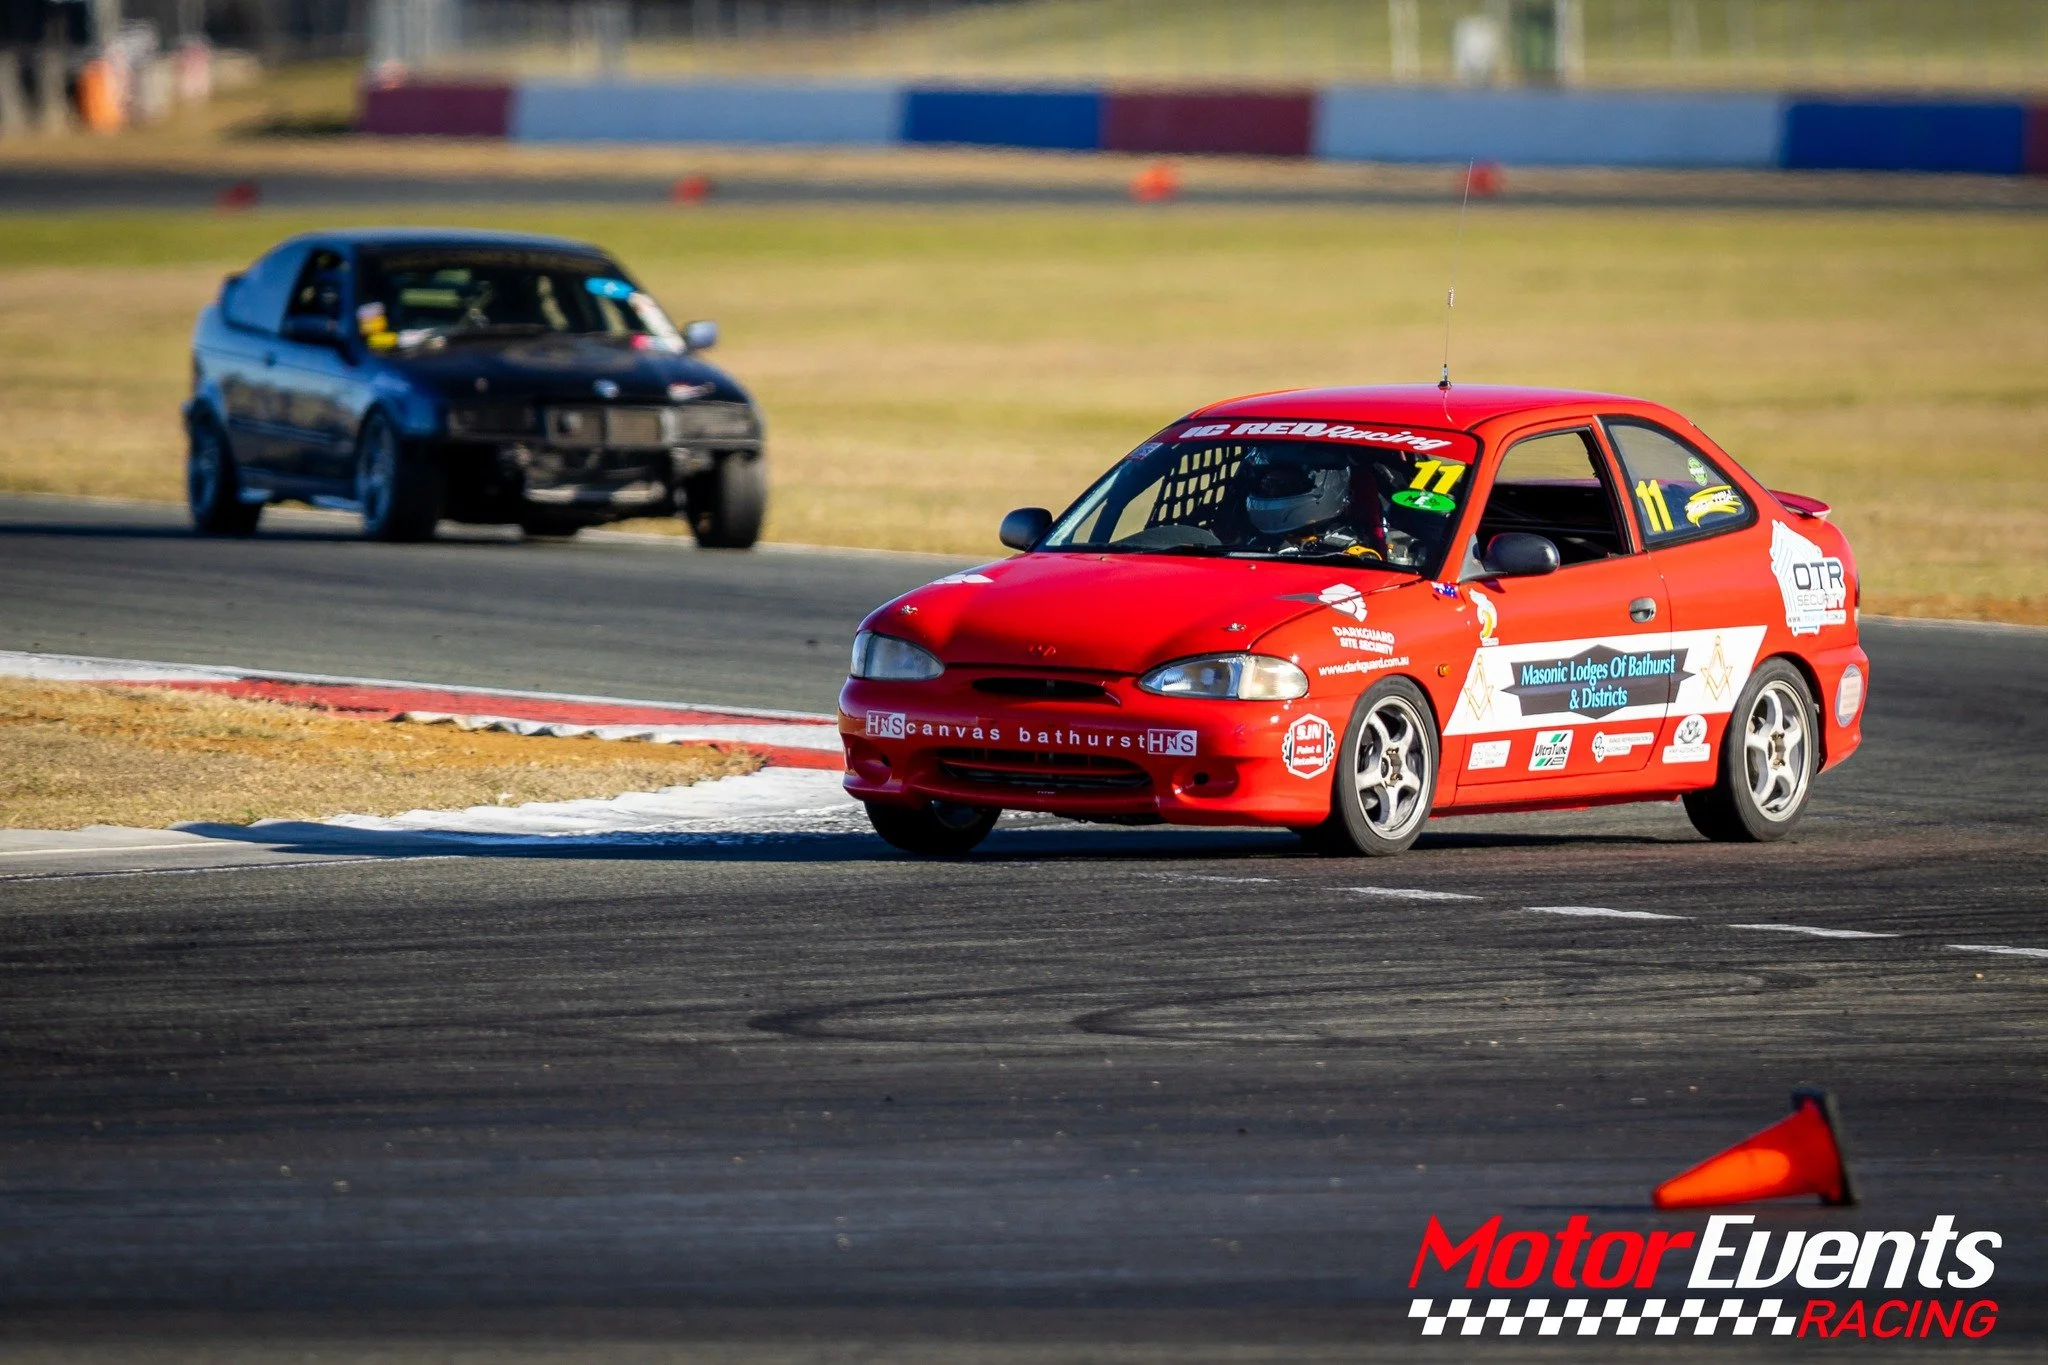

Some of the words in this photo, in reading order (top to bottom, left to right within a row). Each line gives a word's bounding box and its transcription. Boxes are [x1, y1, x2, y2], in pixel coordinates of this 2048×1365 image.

[1409, 459, 1466, 495] 11
[1635, 480, 1674, 533] 11
[1793, 561, 1843, 591] OTR
[1332, 626, 1395, 645] DARKGUARD
[1340, 637, 1358, 649] SITE
[1359, 639, 1394, 656] SECURITY
[1318, 656, 1409, 676] www.darkguard.com.au
[1521, 661, 1568, 686] Masonic
[1570, 657, 1608, 687] Lodges
[1610, 654, 1628, 679] Of
[1628, 652, 1676, 677] Bathurst
[1569, 688, 1580, 710] &
[1582, 684, 1628, 708] Districts
[906, 722, 1000, 740] canvas
[1019, 727, 1145, 748] bathurst
